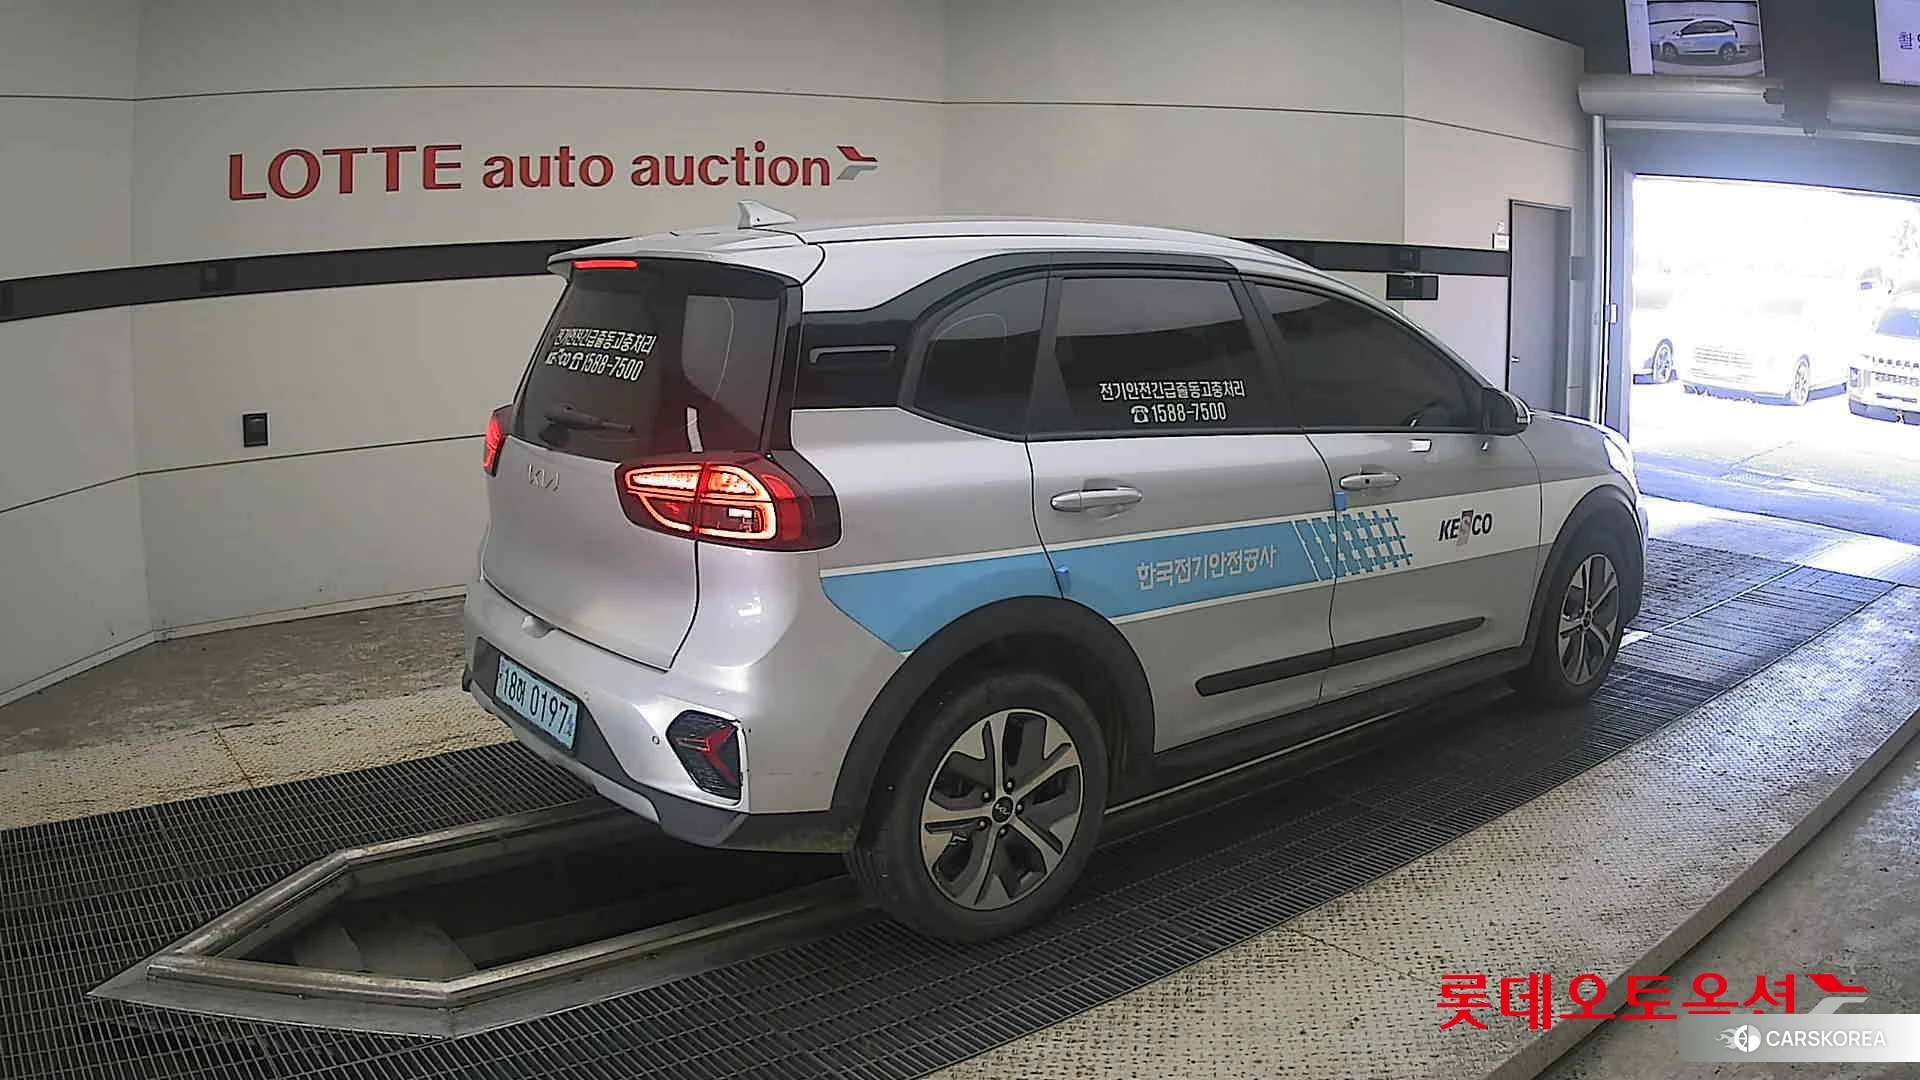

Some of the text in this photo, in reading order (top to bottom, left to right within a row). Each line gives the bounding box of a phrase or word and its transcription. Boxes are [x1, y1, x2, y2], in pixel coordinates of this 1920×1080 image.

[229, 140, 831, 201] LOTTE auto auction
[581, 352, 644, 381] 1588-7500
[1151, 402, 1227, 423] 1588-7500
[1136, 544, 1277, 590] 한국전기안전공사
[530, 685, 569, 733] 0197
